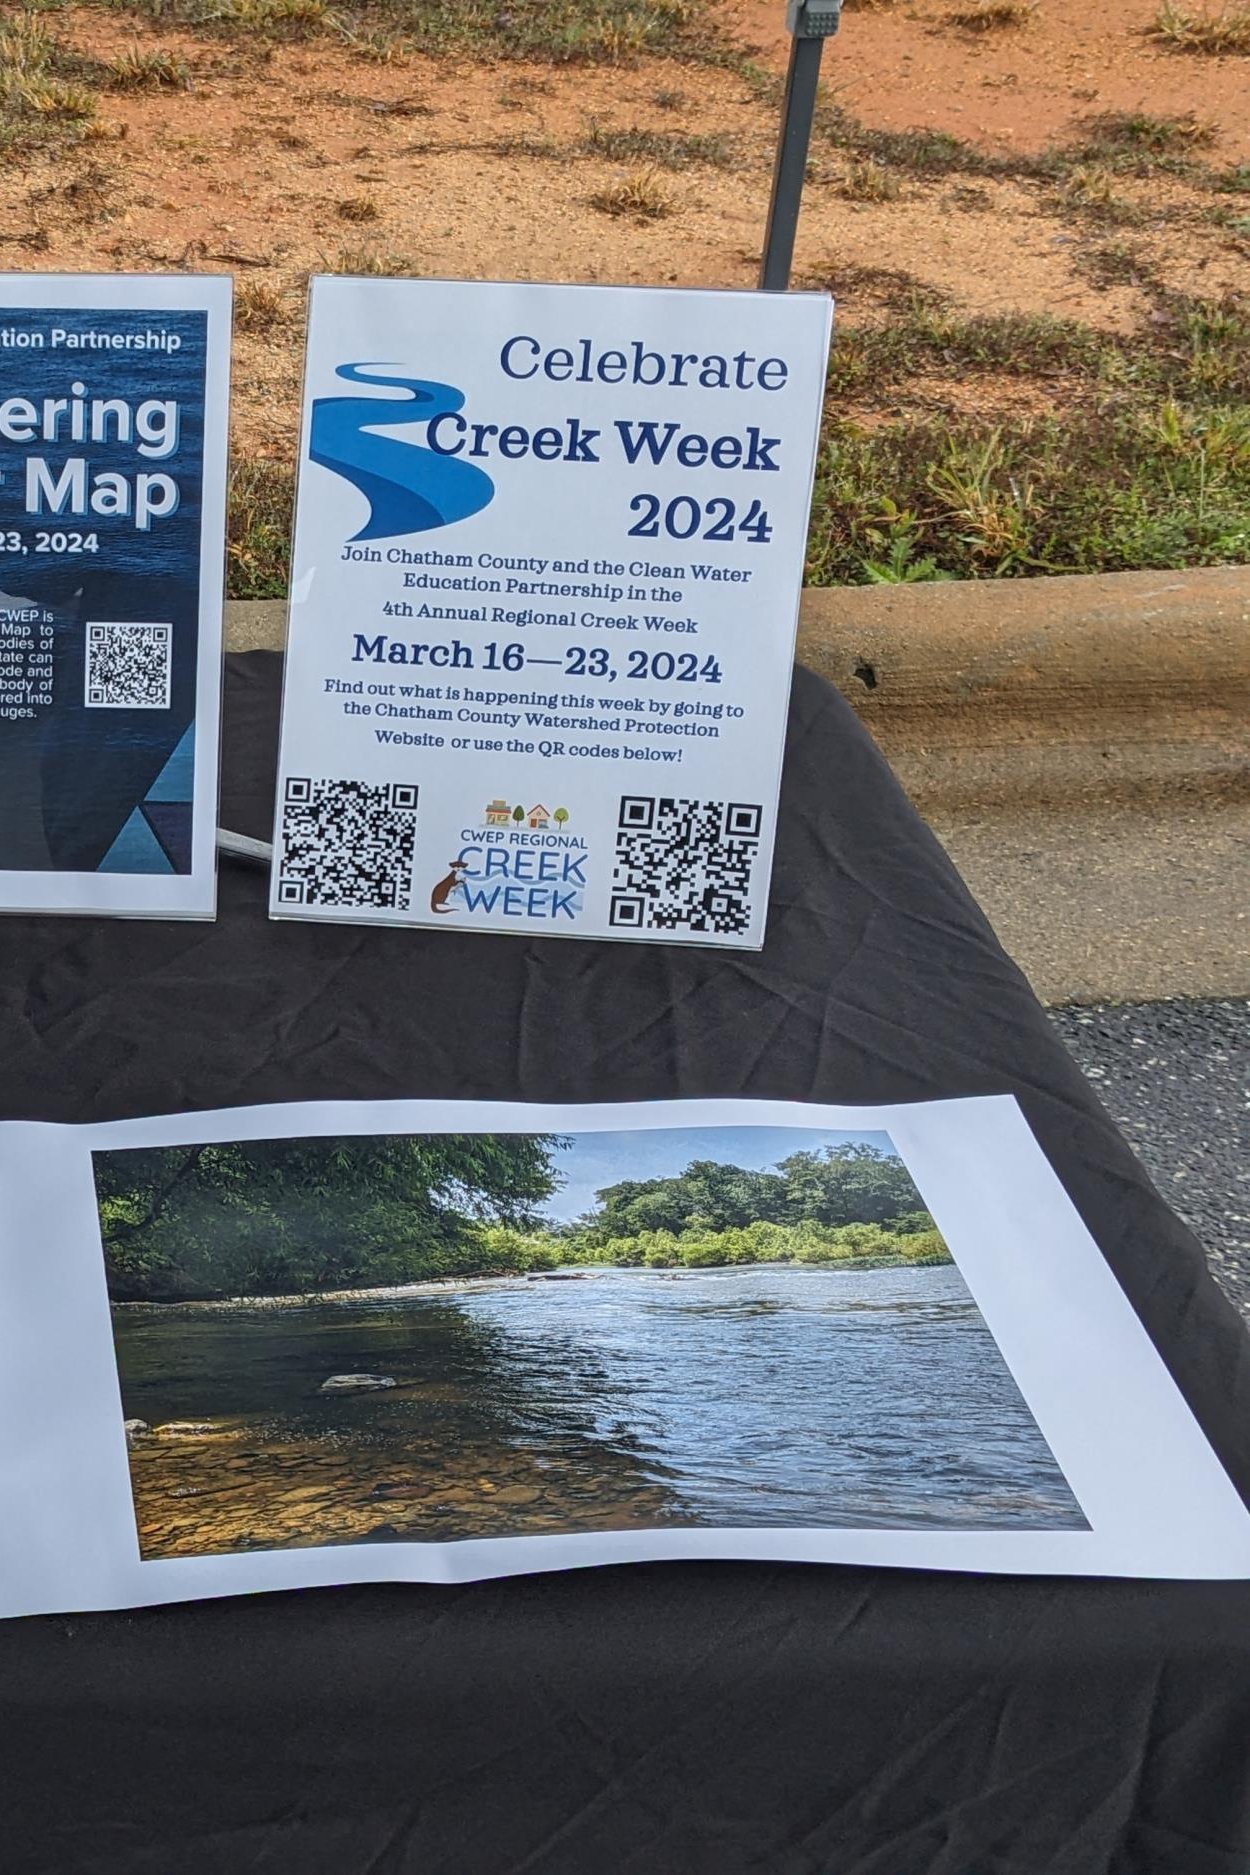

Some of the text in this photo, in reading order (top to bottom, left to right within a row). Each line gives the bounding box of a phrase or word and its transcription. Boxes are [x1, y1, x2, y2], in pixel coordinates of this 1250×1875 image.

[51, 330, 182, 354] Partnership
[499, 335, 789, 393] Celebrate
[426, 411, 781, 473] Creek Week
[25, 457, 180, 530] Map
[628, 494, 773, 544] 2024
[35, 533, 99, 553] 2024
[341, 546, 752, 582] Join Chatham County and the Clean Water
[403, 572, 683, 602] Education Partnership in the
[1, 623, 30, 637] Map
[40, 624, 53, 635] to
[43, 611, 53, 622] is
[382, 601, 699, 633] 4th Annual Regional Creek Week
[28, 653, 52, 663] can
[40, 637, 54, 649] of
[351, 634, 475, 668] March
[626, 650, 724, 683] 2024
[0, 678, 32, 692] body
[39, 678, 52, 690] of
[27, 664, 52, 676] and
[27, 692, 52, 703] into
[324, 679, 744, 719] Find out what is happening this week by going to
[343, 701, 720, 737] the Chatham County Watershed Protection
[374, 730, 682, 762] Website or use the QR codes below!
[461, 829, 588, 849] CWEP REGIONAL
[458, 847, 588, 883] CREEK
[462, 882, 577, 920] WEEK
